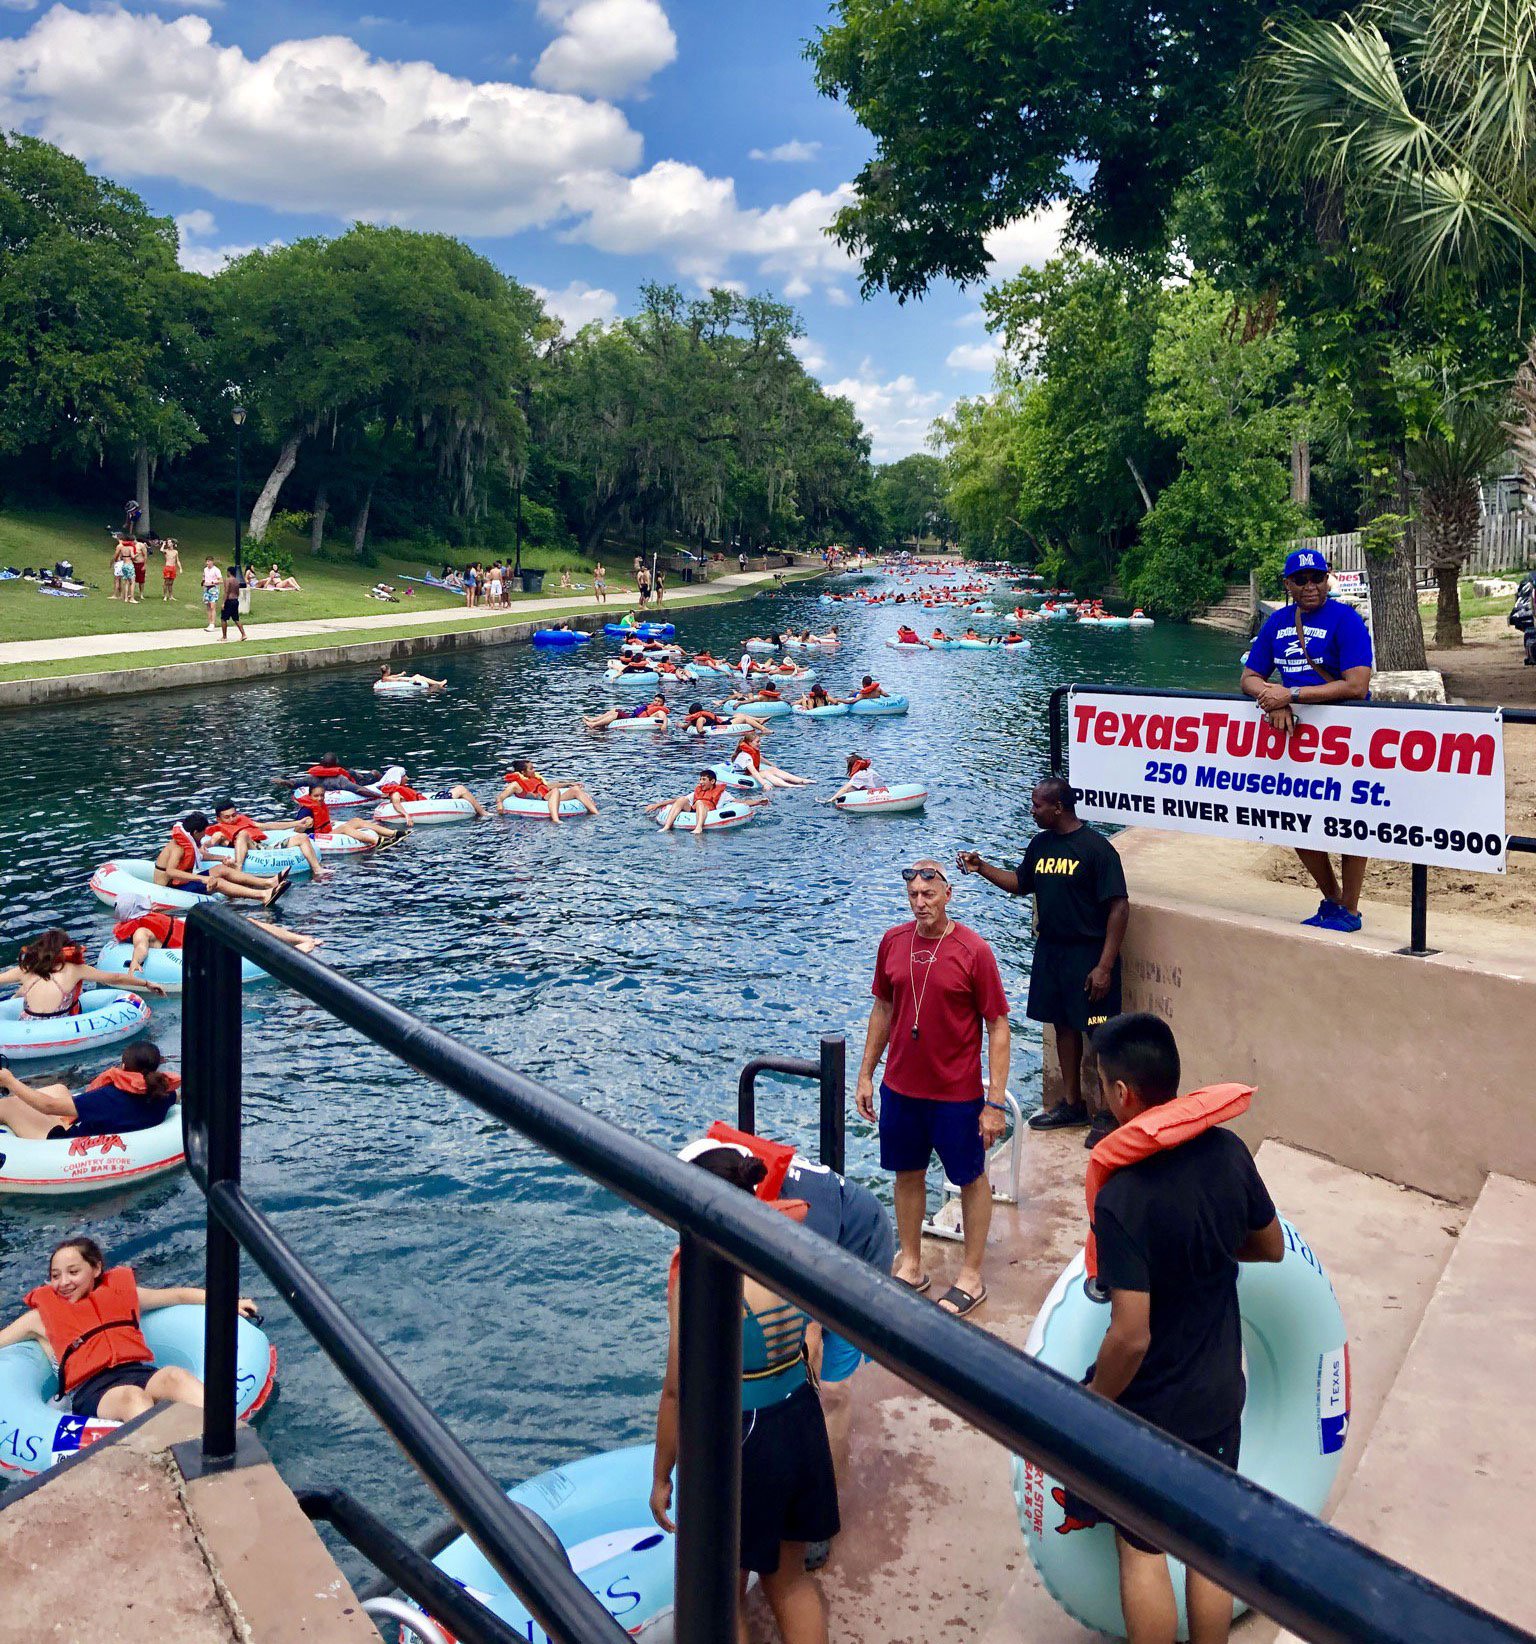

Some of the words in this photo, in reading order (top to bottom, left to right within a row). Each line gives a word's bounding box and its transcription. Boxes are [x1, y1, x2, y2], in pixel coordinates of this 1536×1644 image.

[1299, 553, 1315, 566] M
[1074, 705, 1496, 776] TexasTubes.com
[1144, 761, 1188, 786] 250
[1195, 766, 1342, 801] Meusebach
[1350, 779, 1392, 807] St.
[1071, 788, 1156, 814] PRIVATE
[1162, 797, 1229, 823] RIVER
[1236, 806, 1312, 833] ENTRY
[1323, 816, 1502, 856] 830-626-9900
[1035, 857, 1080, 876] ARMY
[66, 1008, 138, 1033] TEXAS
[1087, 1015, 1108, 1026] ARMY
